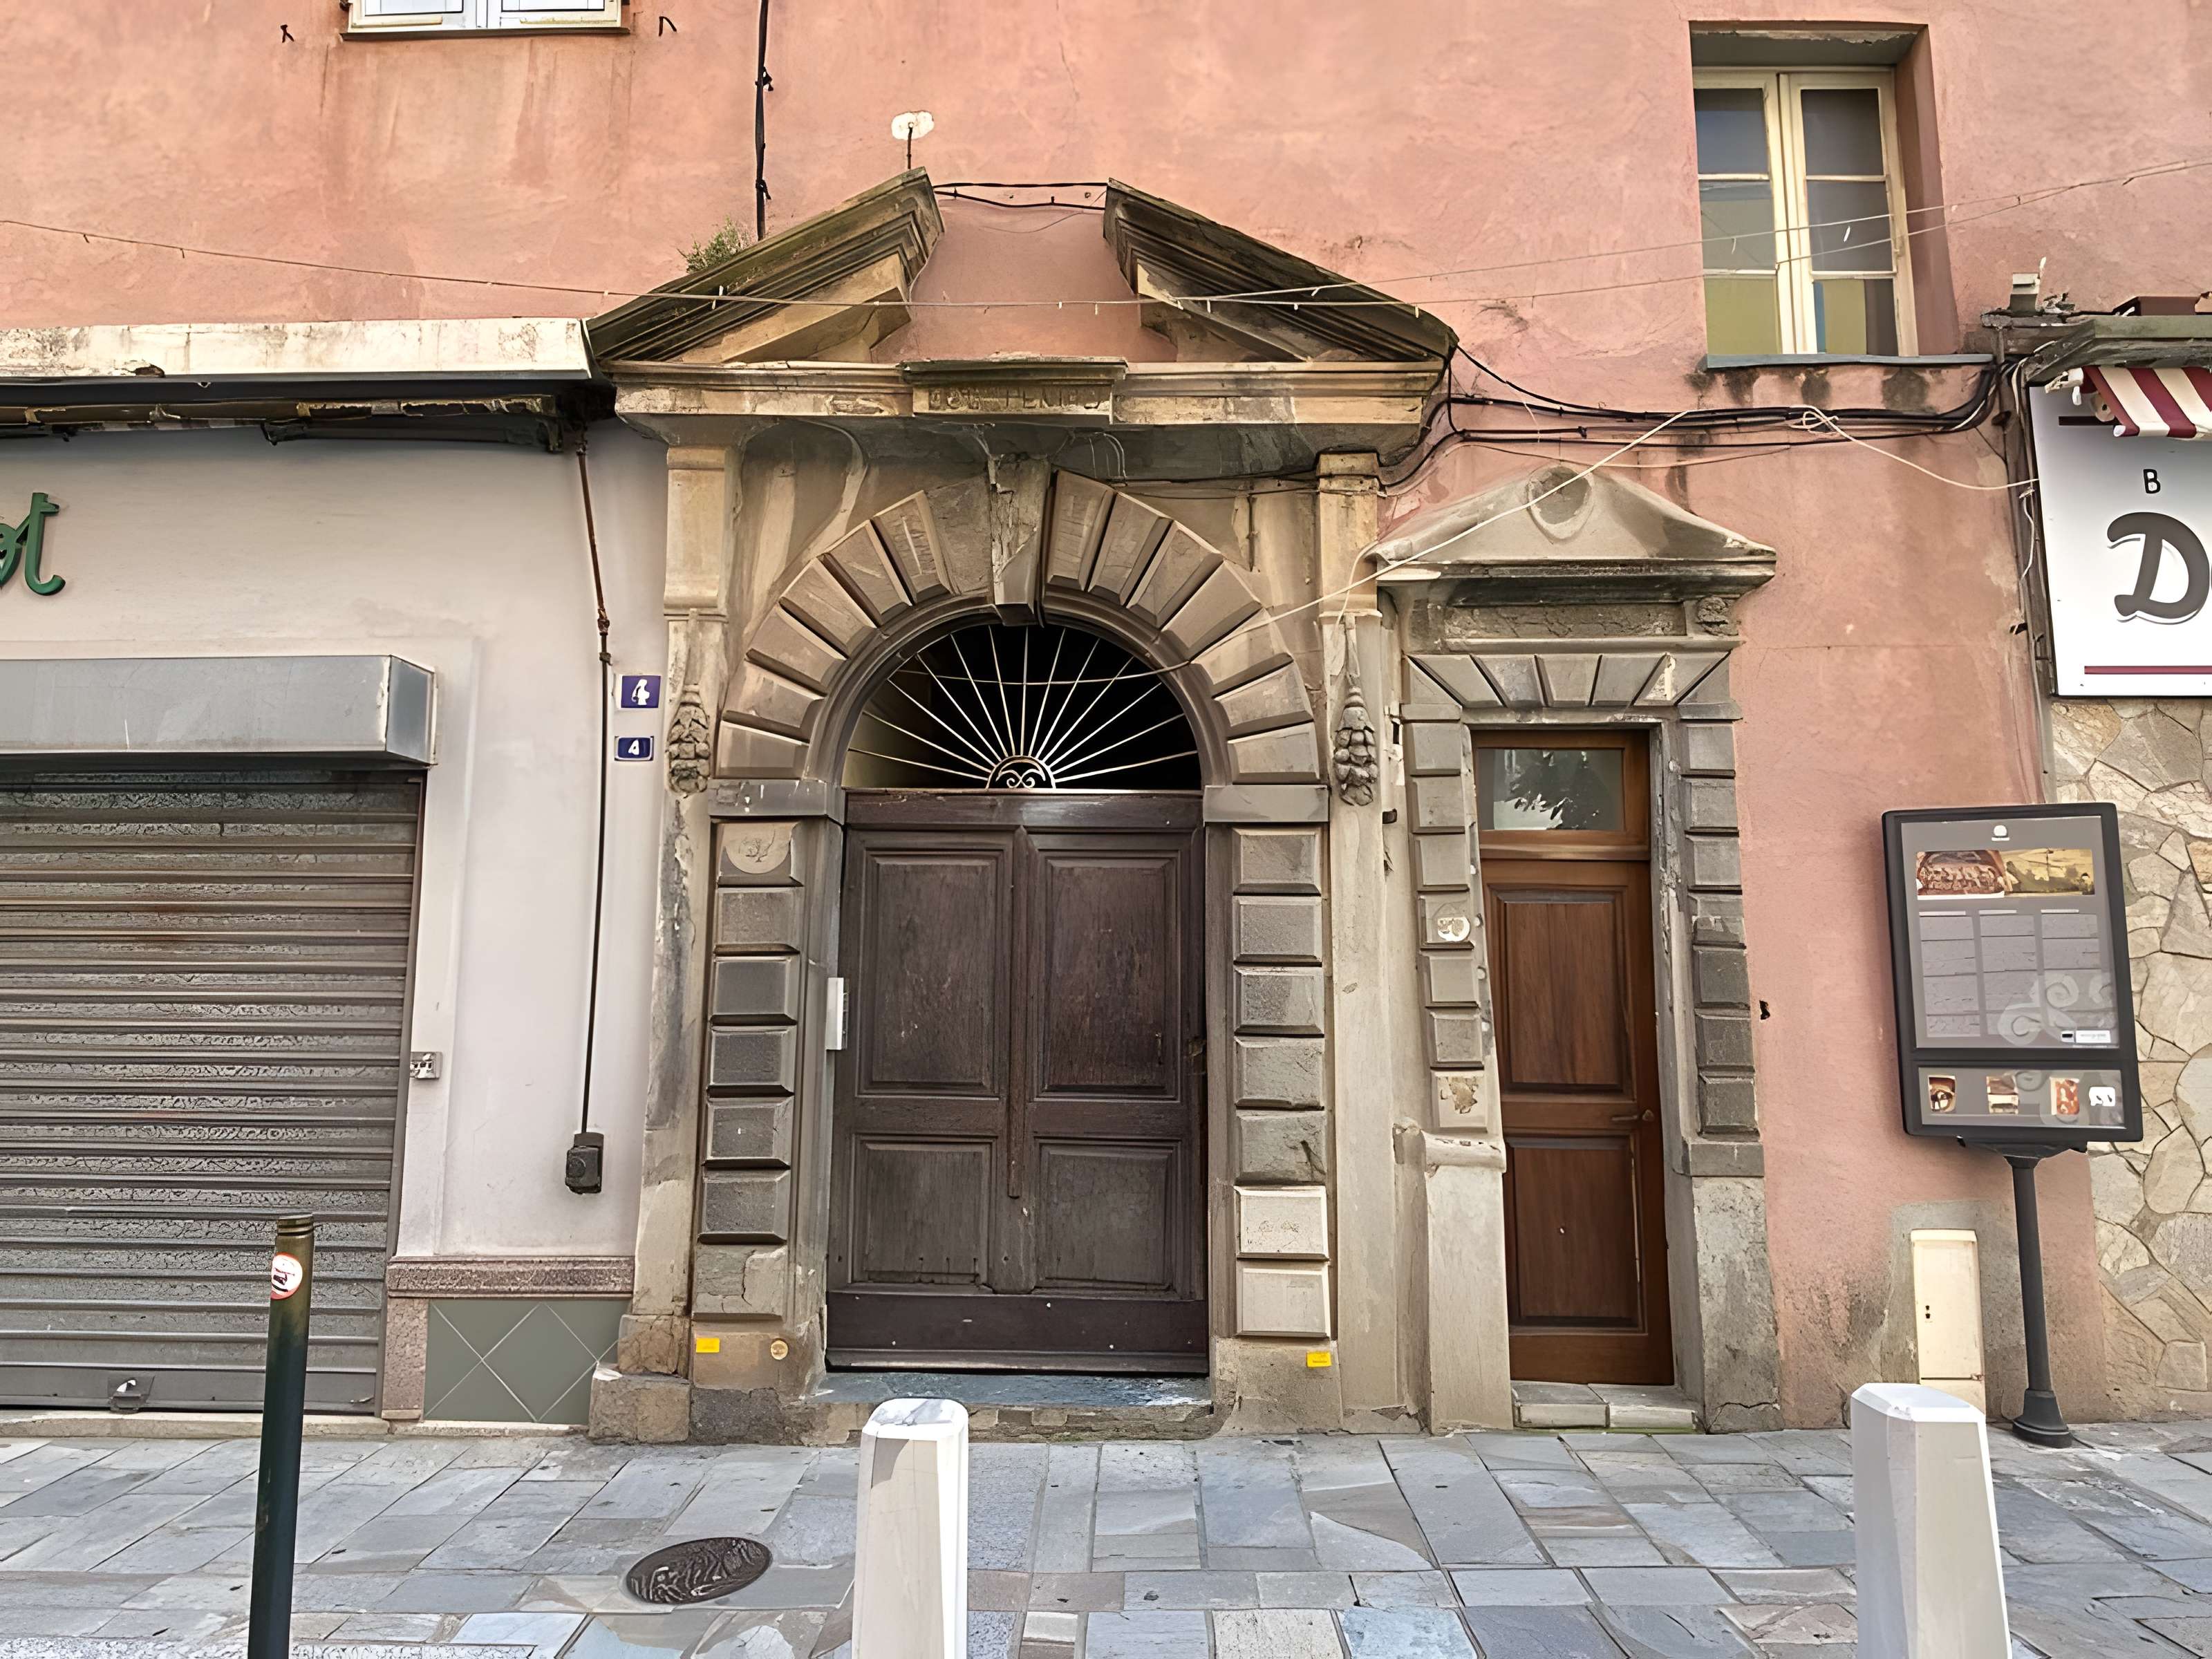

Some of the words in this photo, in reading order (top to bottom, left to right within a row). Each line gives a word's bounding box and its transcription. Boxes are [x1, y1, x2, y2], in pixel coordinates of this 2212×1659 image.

[2143, 469, 2161, 494] B
[2106, 512, 2212, 621] D
[631, 678, 650, 706] 4
